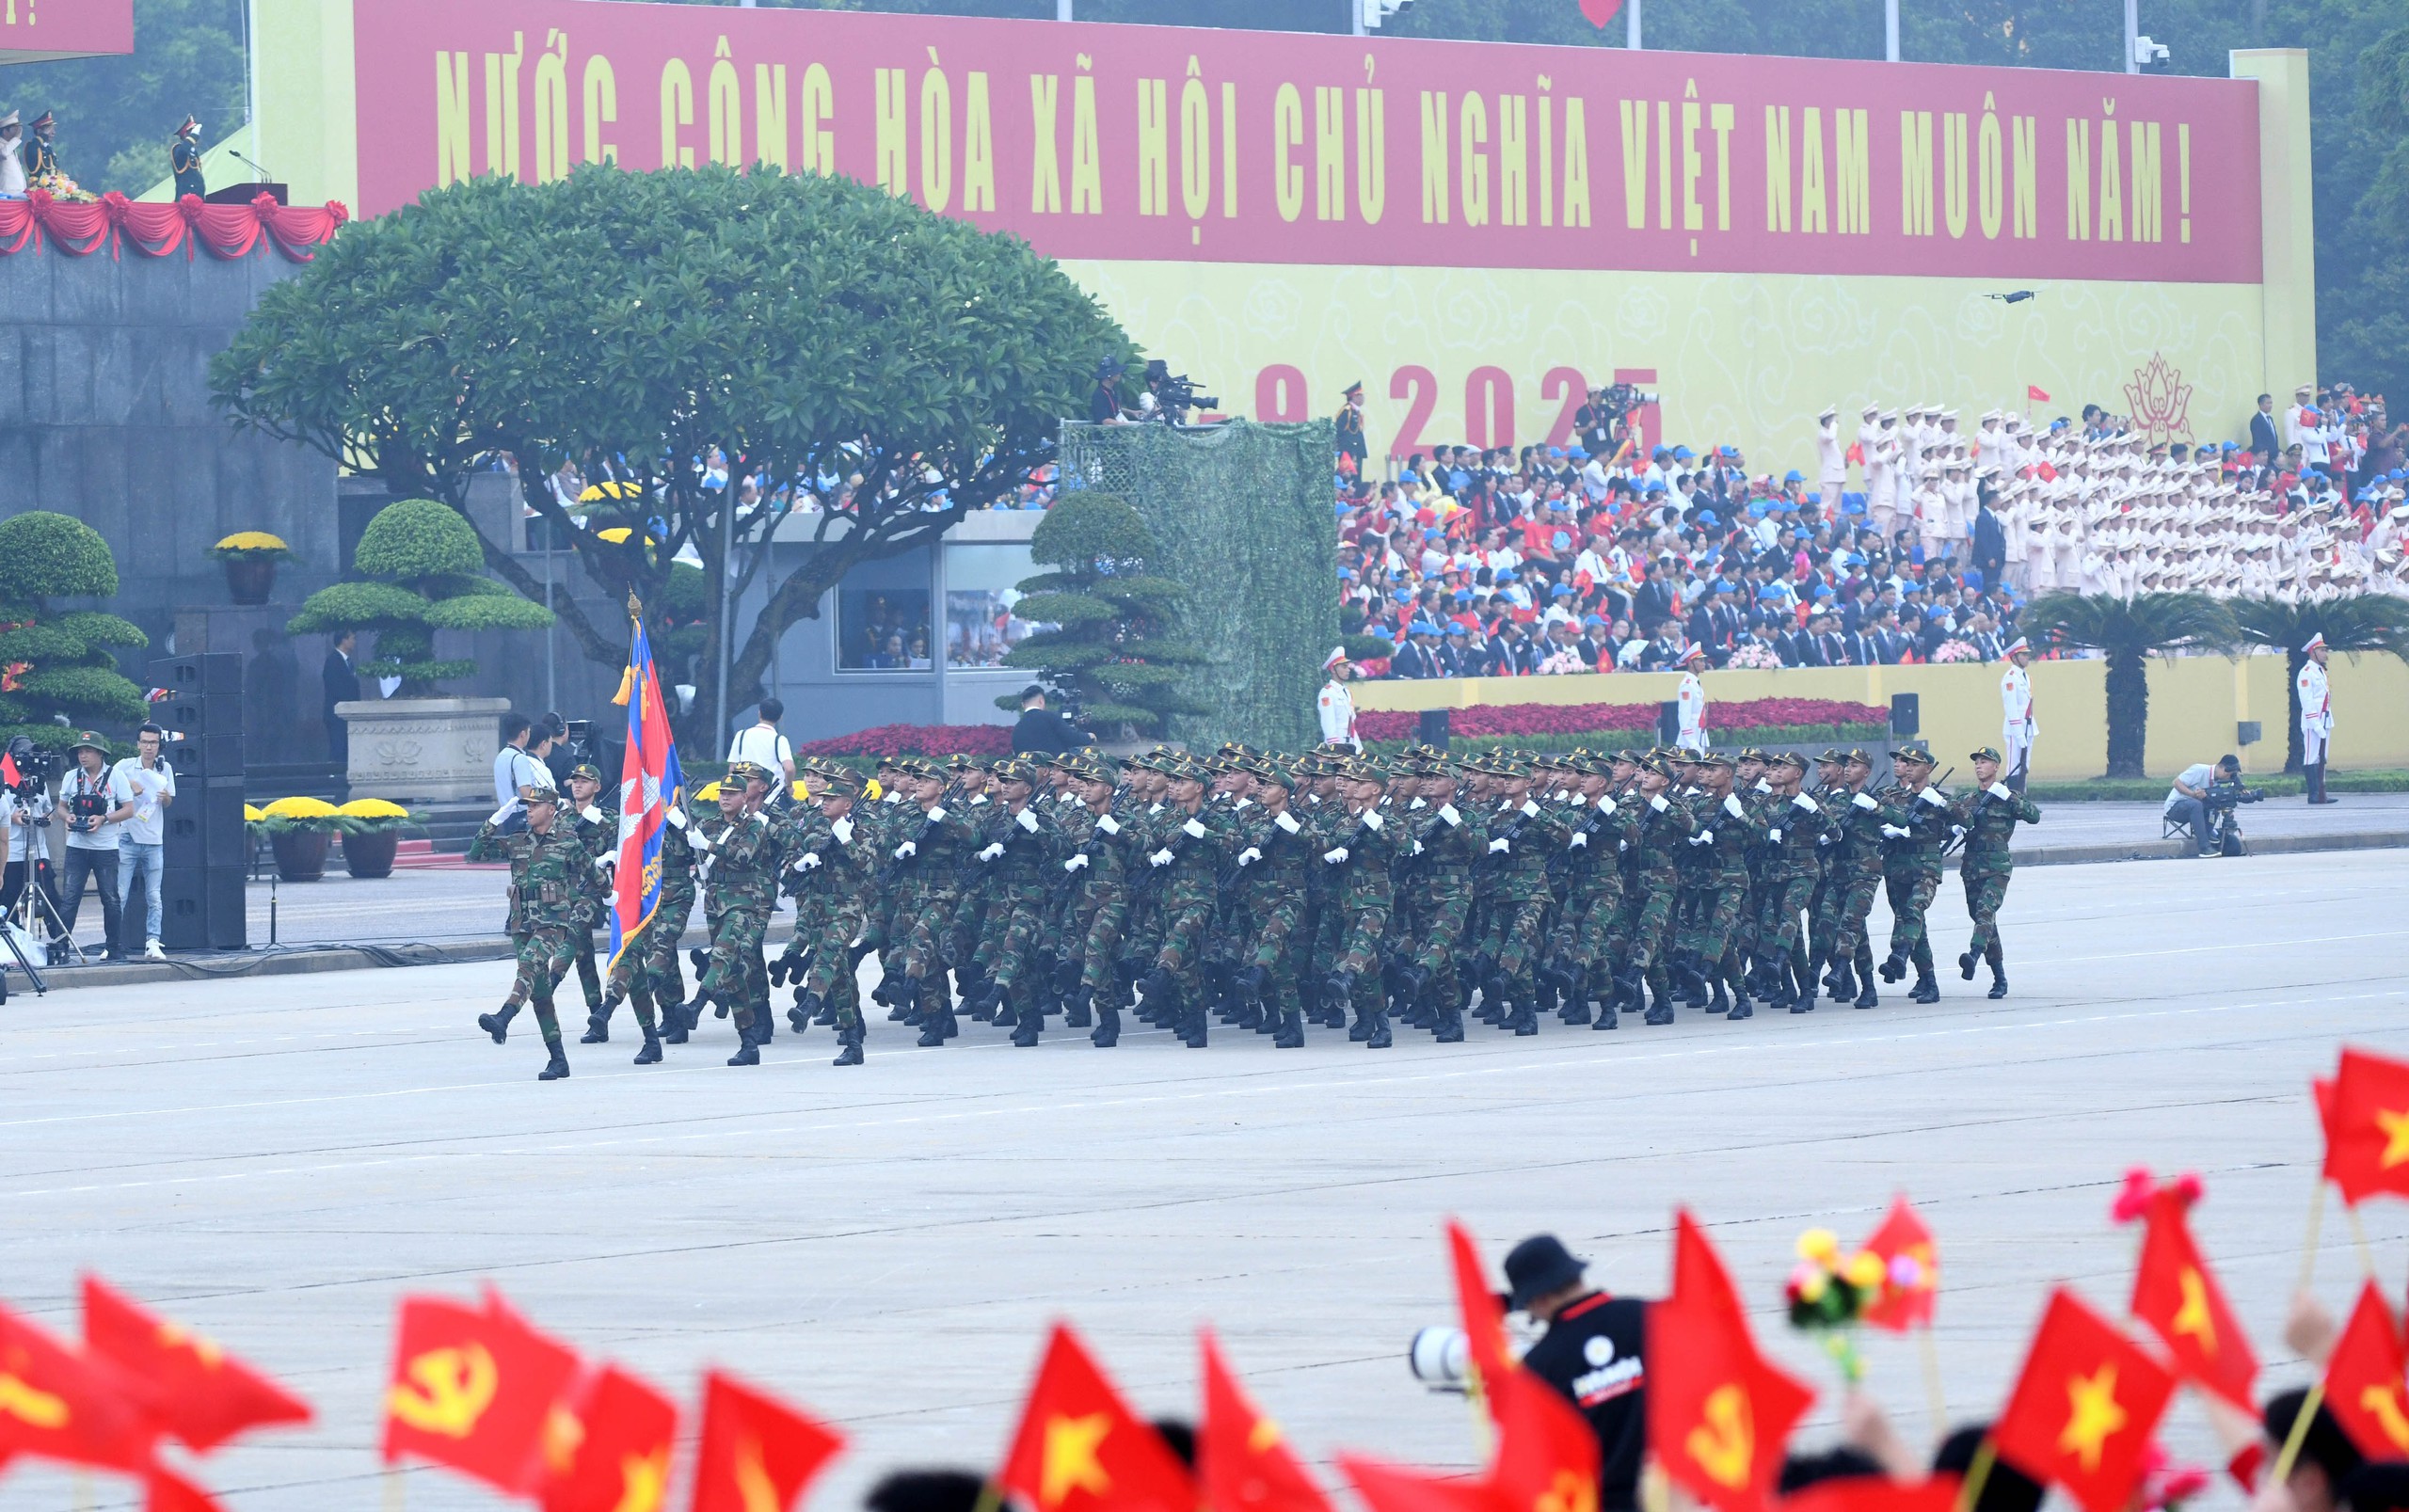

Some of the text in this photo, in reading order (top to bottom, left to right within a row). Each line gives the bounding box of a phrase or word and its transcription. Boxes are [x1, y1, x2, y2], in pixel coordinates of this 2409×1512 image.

[436, 28, 618, 194] NƯỚC
[661, 35, 837, 184] CÔNG
[875, 46, 996, 214] HÒA
[1030, 54, 1102, 215] XÃ
[1139, 55, 1237, 246] HỘI
[1275, 54, 1385, 225] CHỦ
[1421, 74, 1591, 227] NGHĨA
[1620, 78, 1734, 257] VIỆT
[1765, 105, 1870, 234] NAM
[1901, 91, 2036, 239] MUÔN
